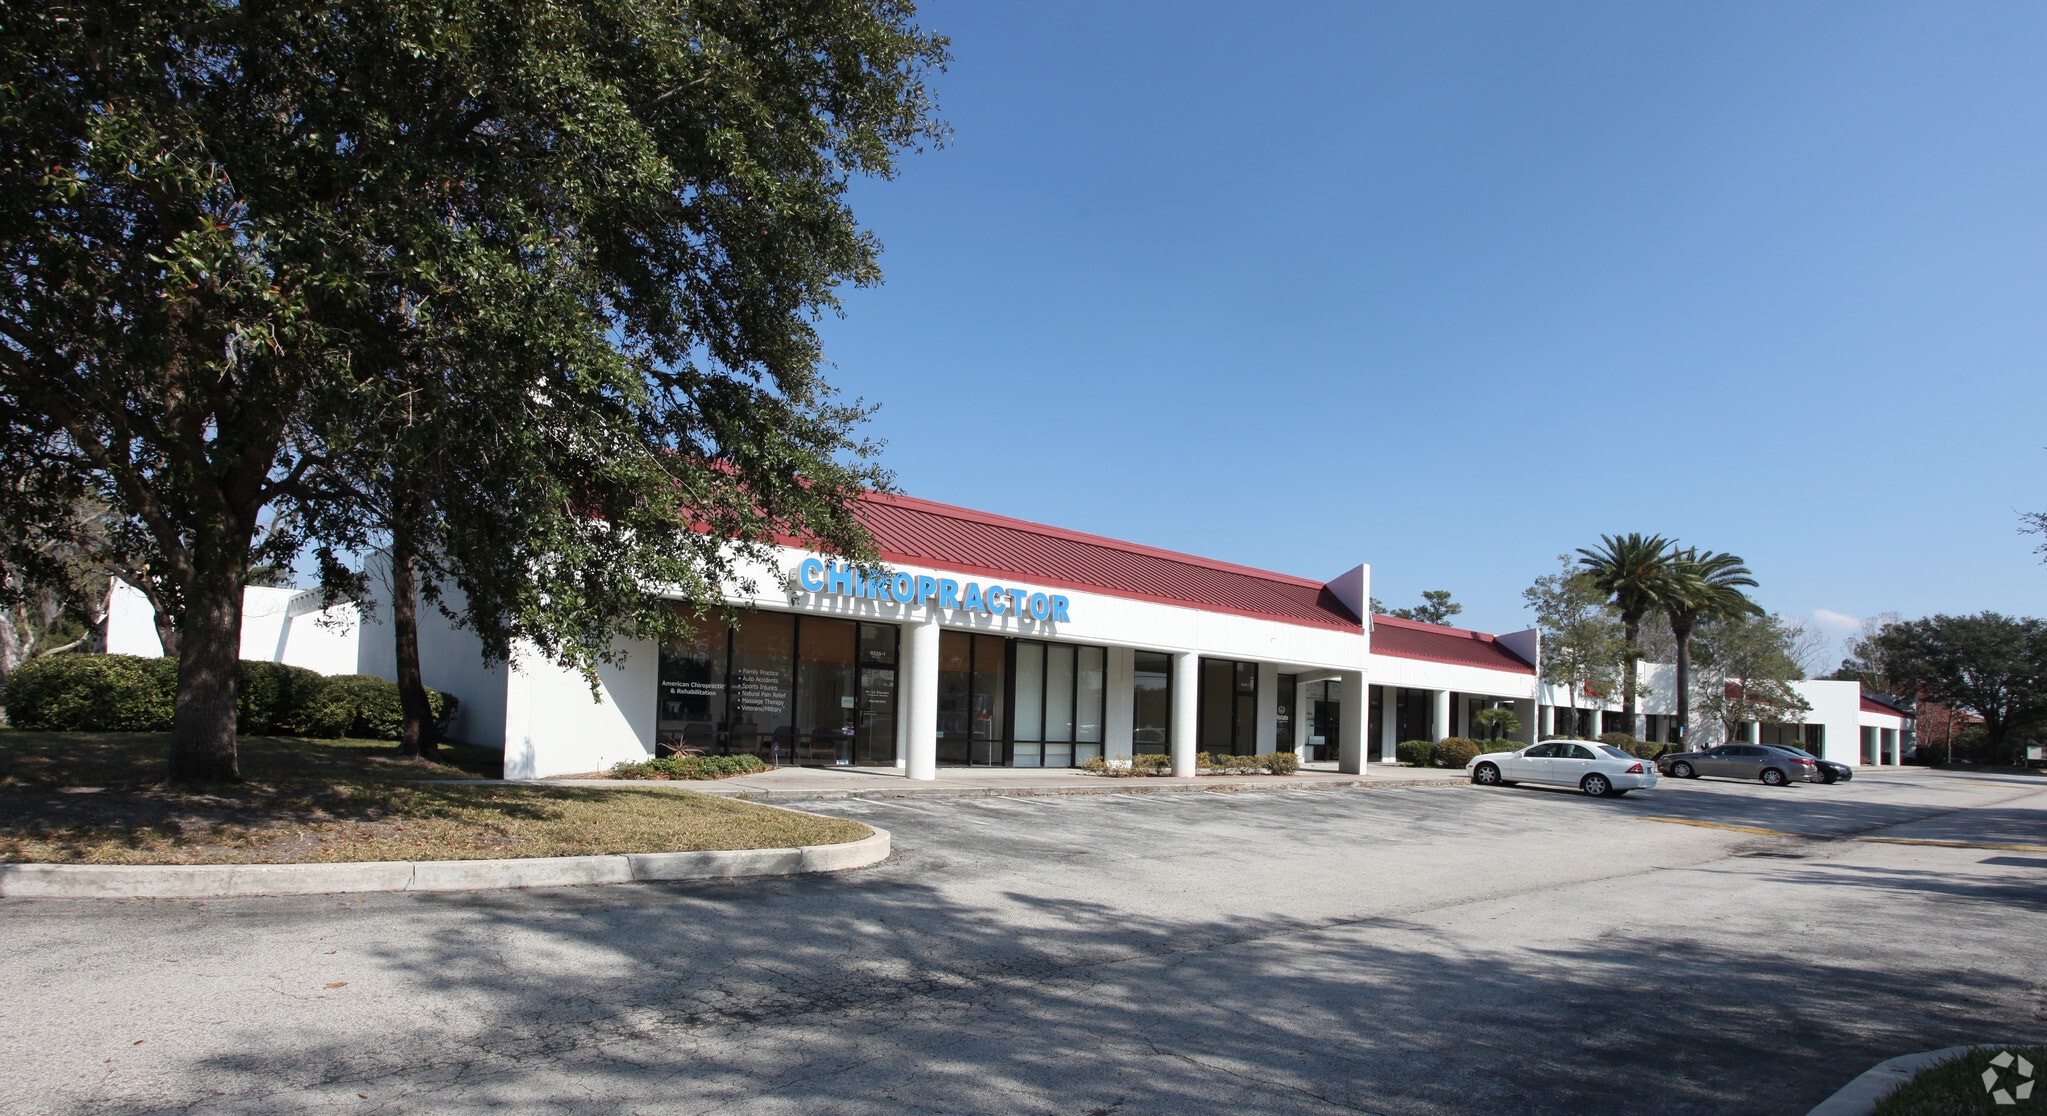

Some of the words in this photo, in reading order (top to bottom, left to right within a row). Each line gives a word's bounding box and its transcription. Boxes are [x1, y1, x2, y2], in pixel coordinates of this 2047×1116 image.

[799, 557, 1071, 624] CHIROPRACTOR
[742, 668, 759, 676] Family
[755, 676, 779, 684] Accidents
[690, 681, 726, 690] Chiropractic
[676, 688, 717, 696] Rehabilitation
[764, 698, 784, 706] Therapy
